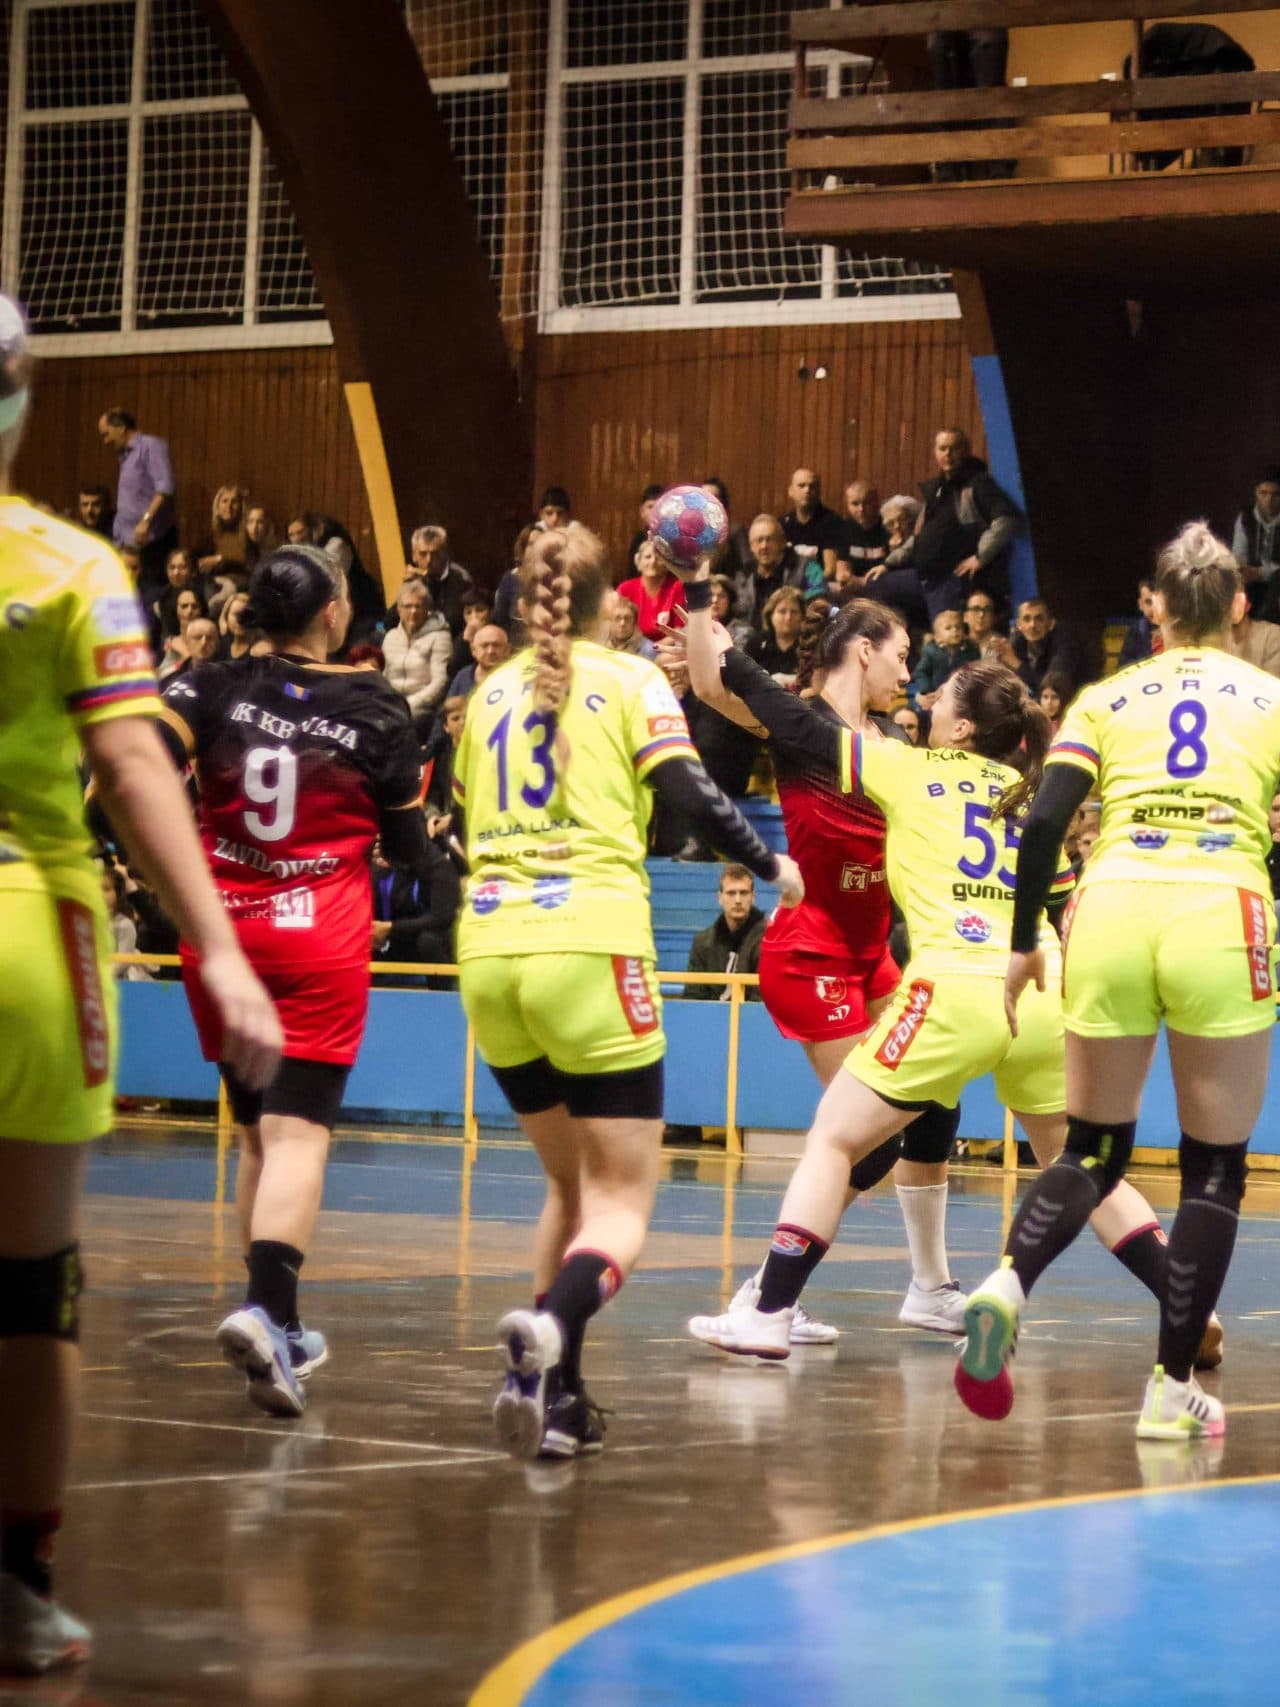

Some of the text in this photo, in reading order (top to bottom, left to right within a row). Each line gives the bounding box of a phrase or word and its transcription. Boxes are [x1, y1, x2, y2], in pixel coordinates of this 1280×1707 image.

[1110, 679, 1272, 712] BORAC
[258, 711, 358, 750] KRVAJA
[1166, 700, 1208, 779] 8
[486, 706, 559, 810] 13
[244, 745, 297, 842] 9
[530, 817, 580, 834] LUKA
[1131, 805, 1205, 823] guma
